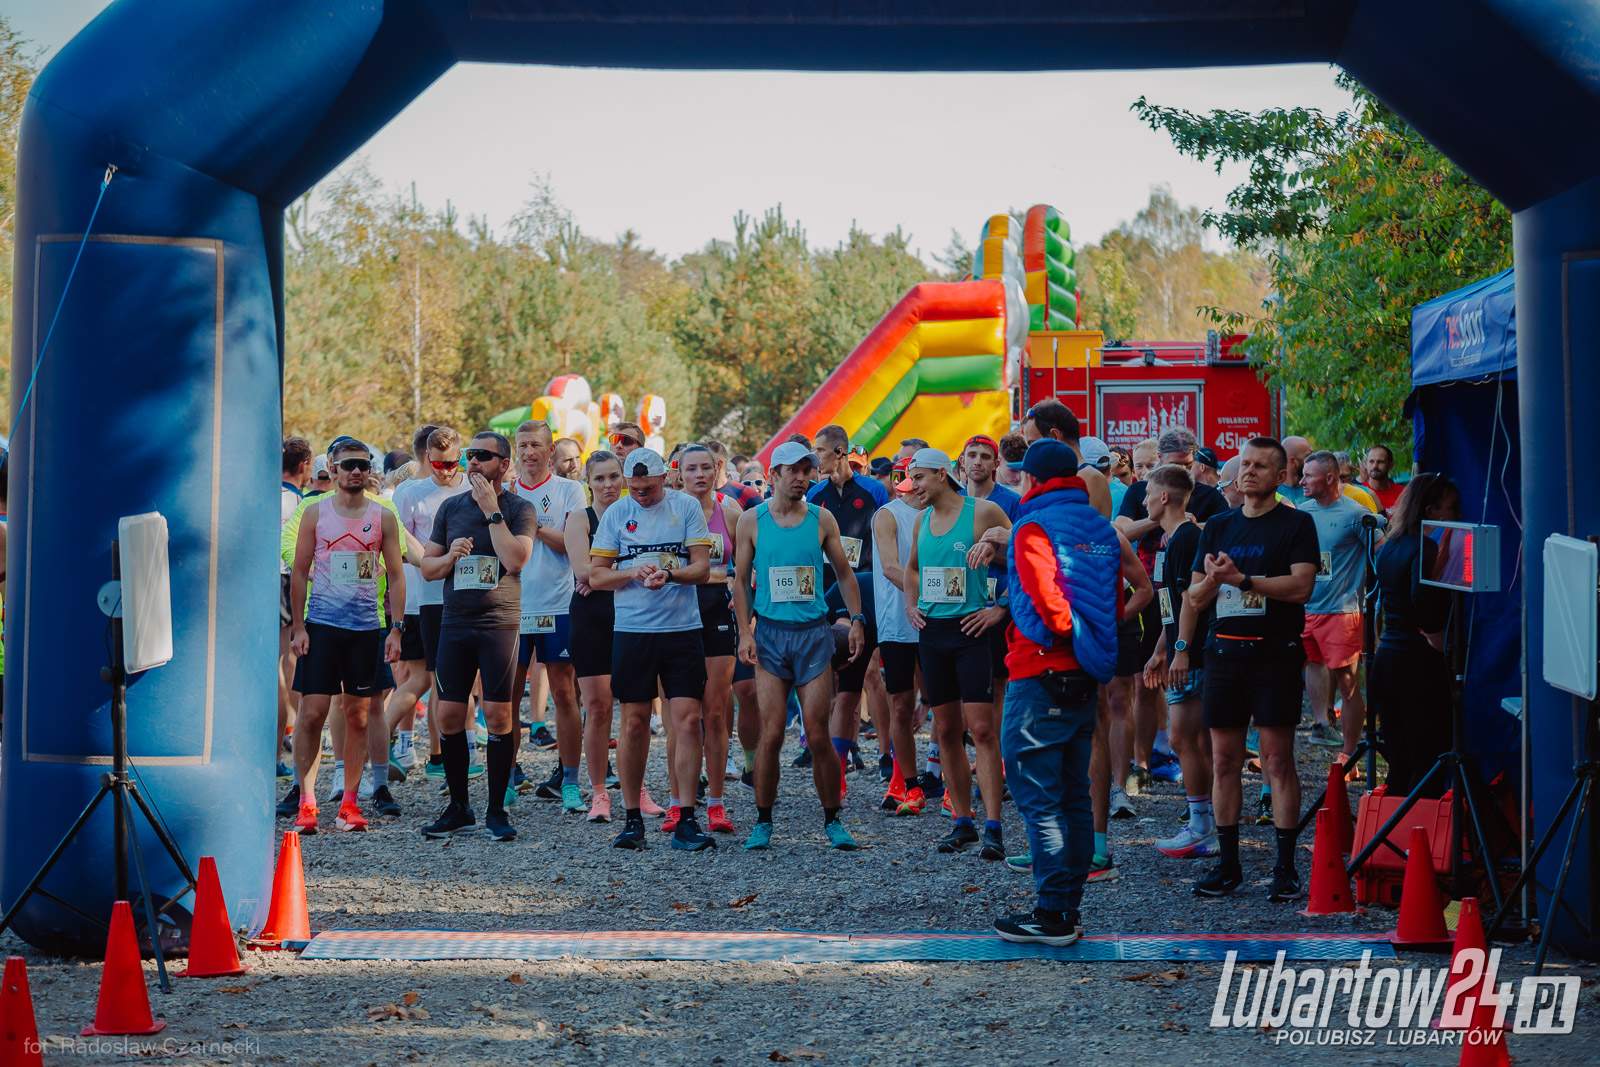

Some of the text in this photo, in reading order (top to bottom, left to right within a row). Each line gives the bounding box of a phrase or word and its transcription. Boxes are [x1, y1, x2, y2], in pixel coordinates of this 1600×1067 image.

[341, 562, 348, 570] 4
[460, 566, 474, 575] 123
[776, 577, 793, 587] 165
[927, 578, 941, 588] 258
[1225, 590, 1232, 600] 3
